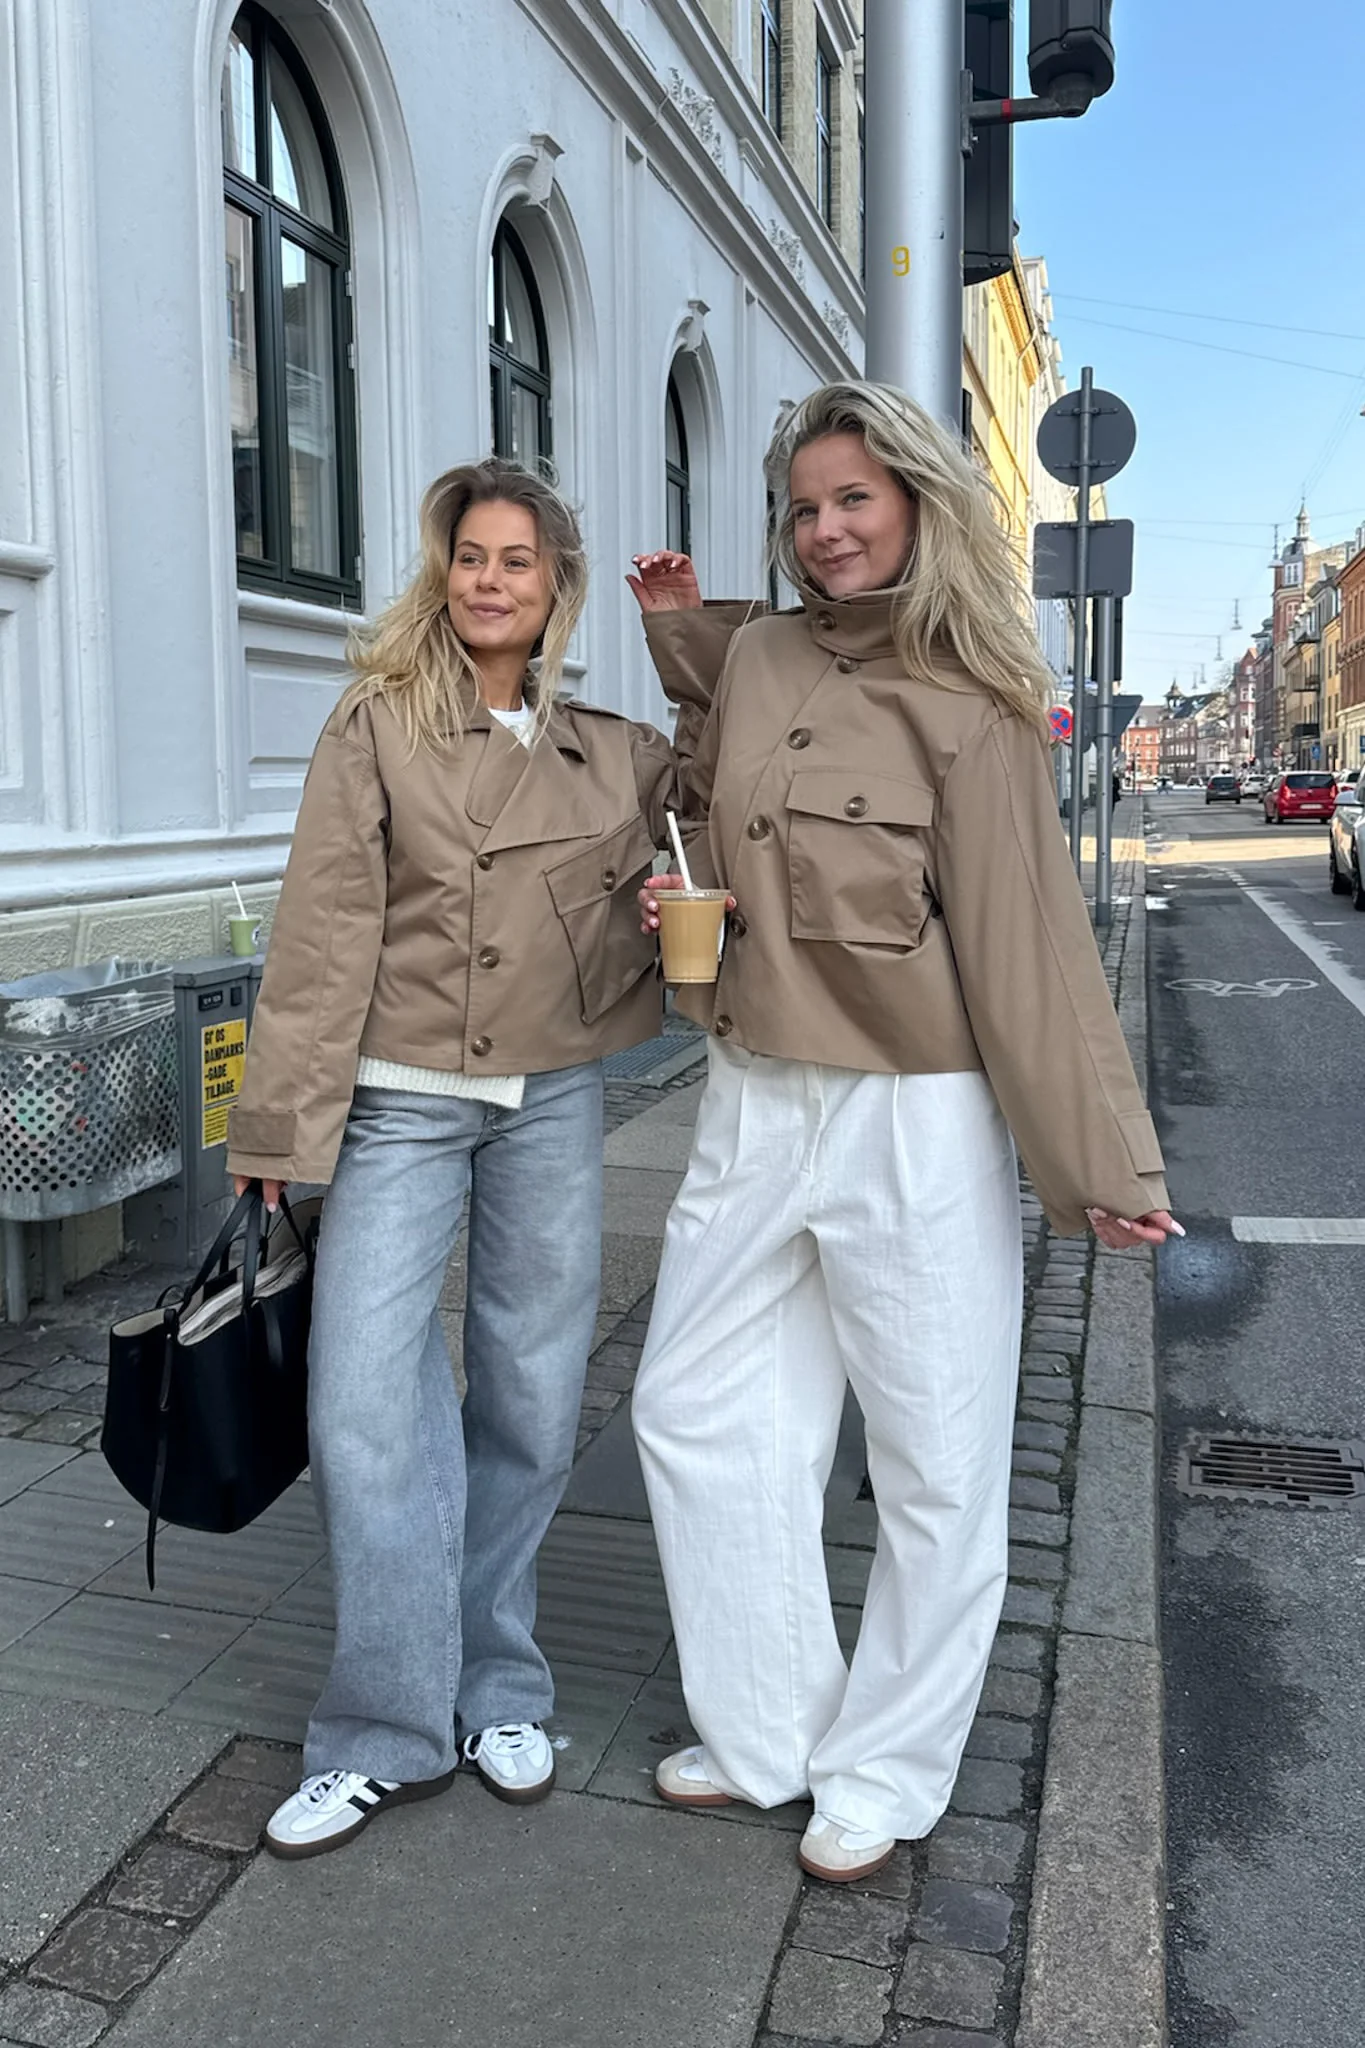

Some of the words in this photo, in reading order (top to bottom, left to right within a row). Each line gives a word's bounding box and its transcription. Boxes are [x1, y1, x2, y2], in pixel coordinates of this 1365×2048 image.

[892, 246, 909, 276] 9
[216, 1028, 225, 1042] OS
[205, 1041, 244, 1064] DANMARKS
[205, 1079, 234, 1100] TILBAGE
